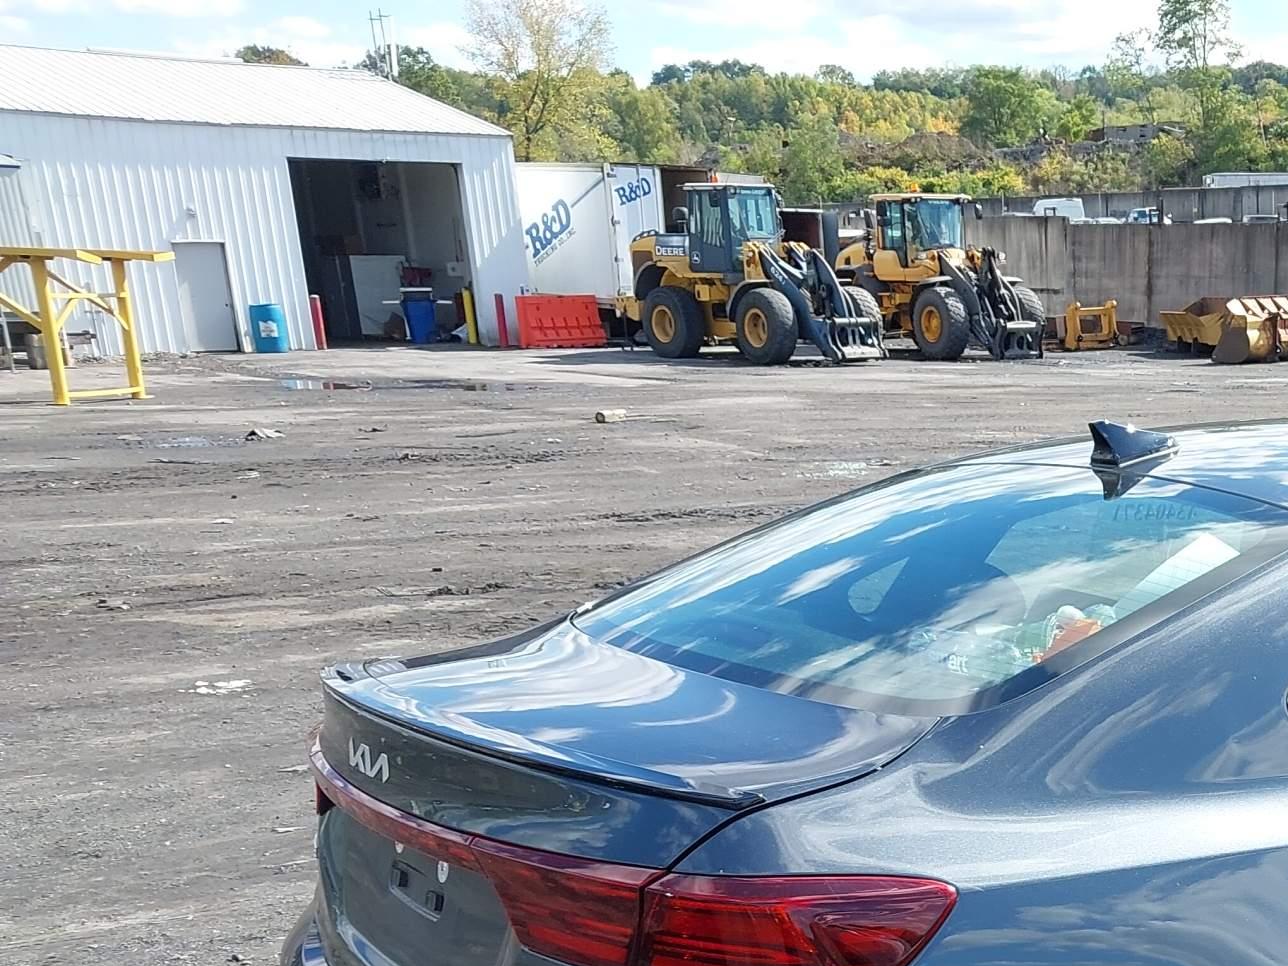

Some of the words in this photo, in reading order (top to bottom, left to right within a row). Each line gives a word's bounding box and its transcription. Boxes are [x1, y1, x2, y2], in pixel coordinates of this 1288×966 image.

[615, 177, 651, 206] R&D
[525, 199, 572, 258] R&D
[655, 246, 685, 256] DEERE
[349, 736, 390, 784] KIA
